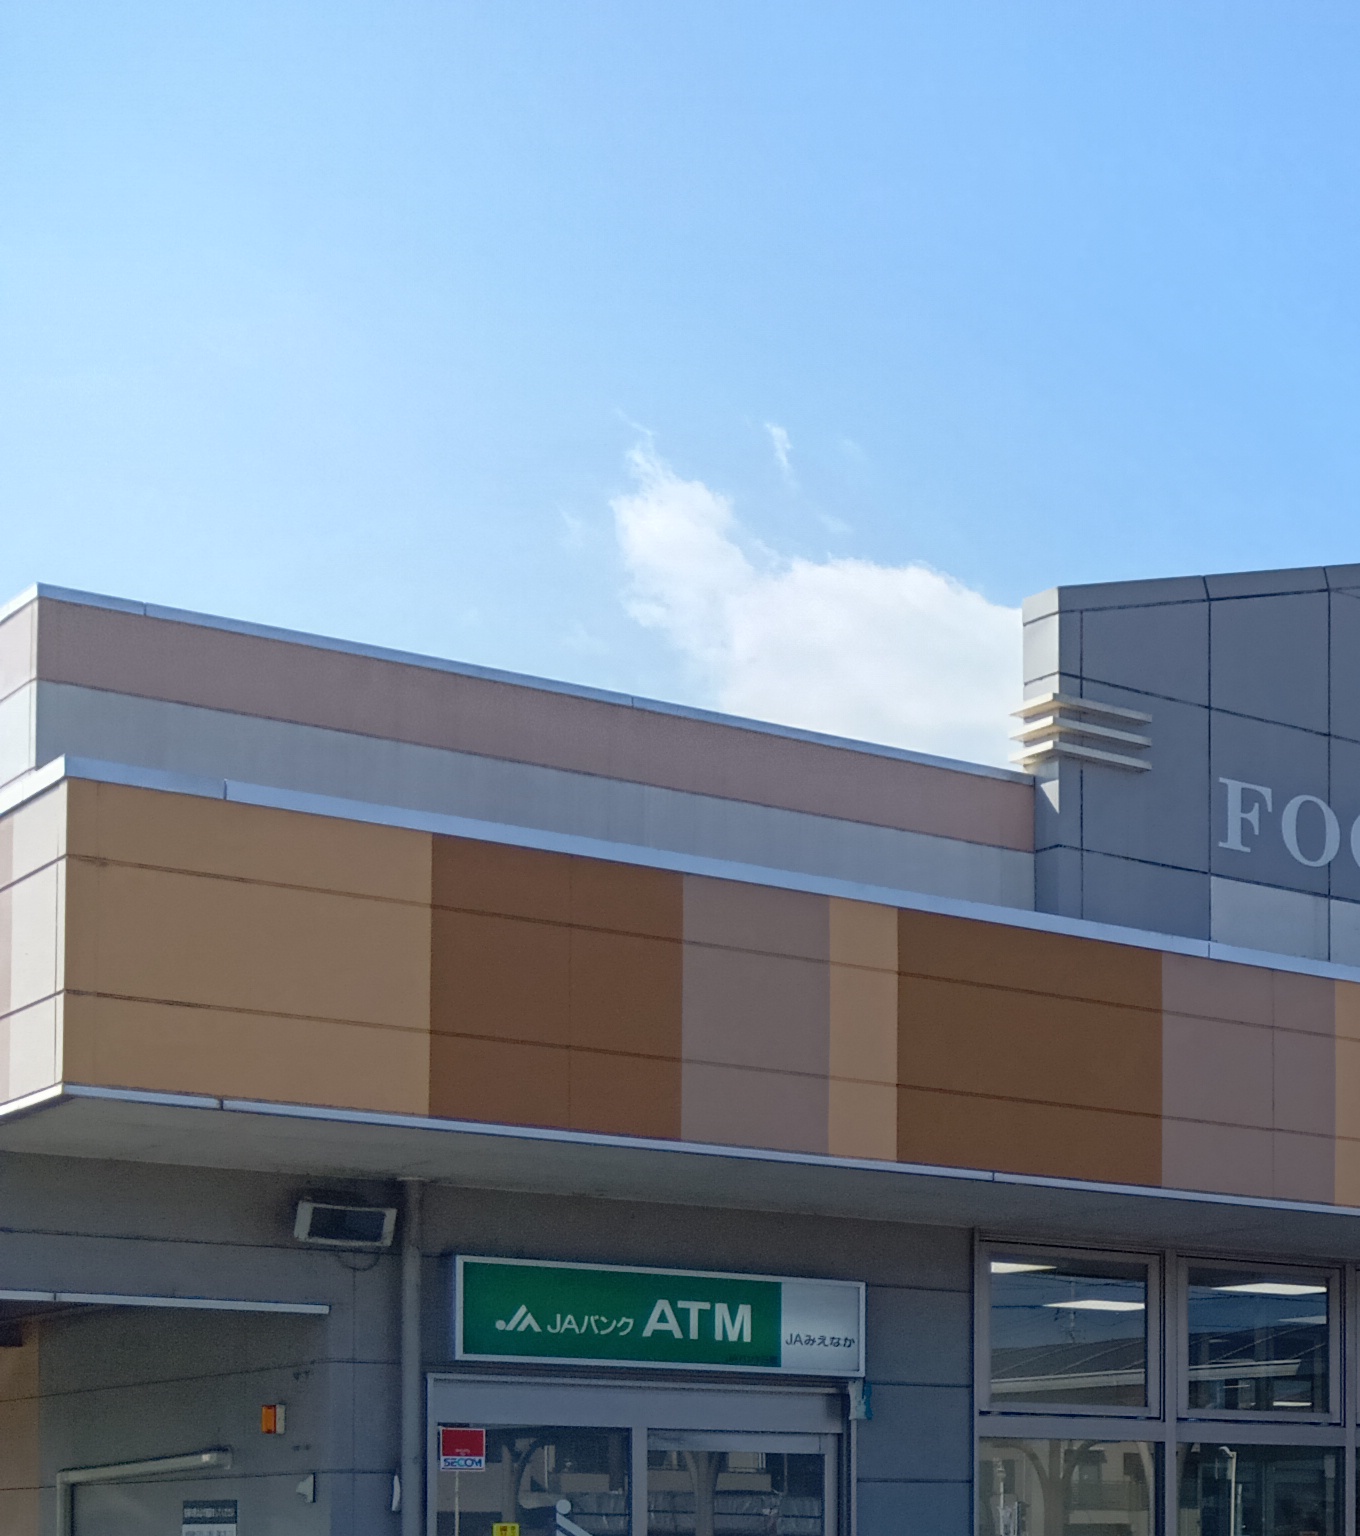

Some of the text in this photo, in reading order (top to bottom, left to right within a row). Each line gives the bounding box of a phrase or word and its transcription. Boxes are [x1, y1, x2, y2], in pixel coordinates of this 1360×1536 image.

[546, 1299, 752, 1343] JAバンク ATM
[785, 1332, 856, 1348] JAみえなか
[443, 1457, 482, 1468] SECOM
